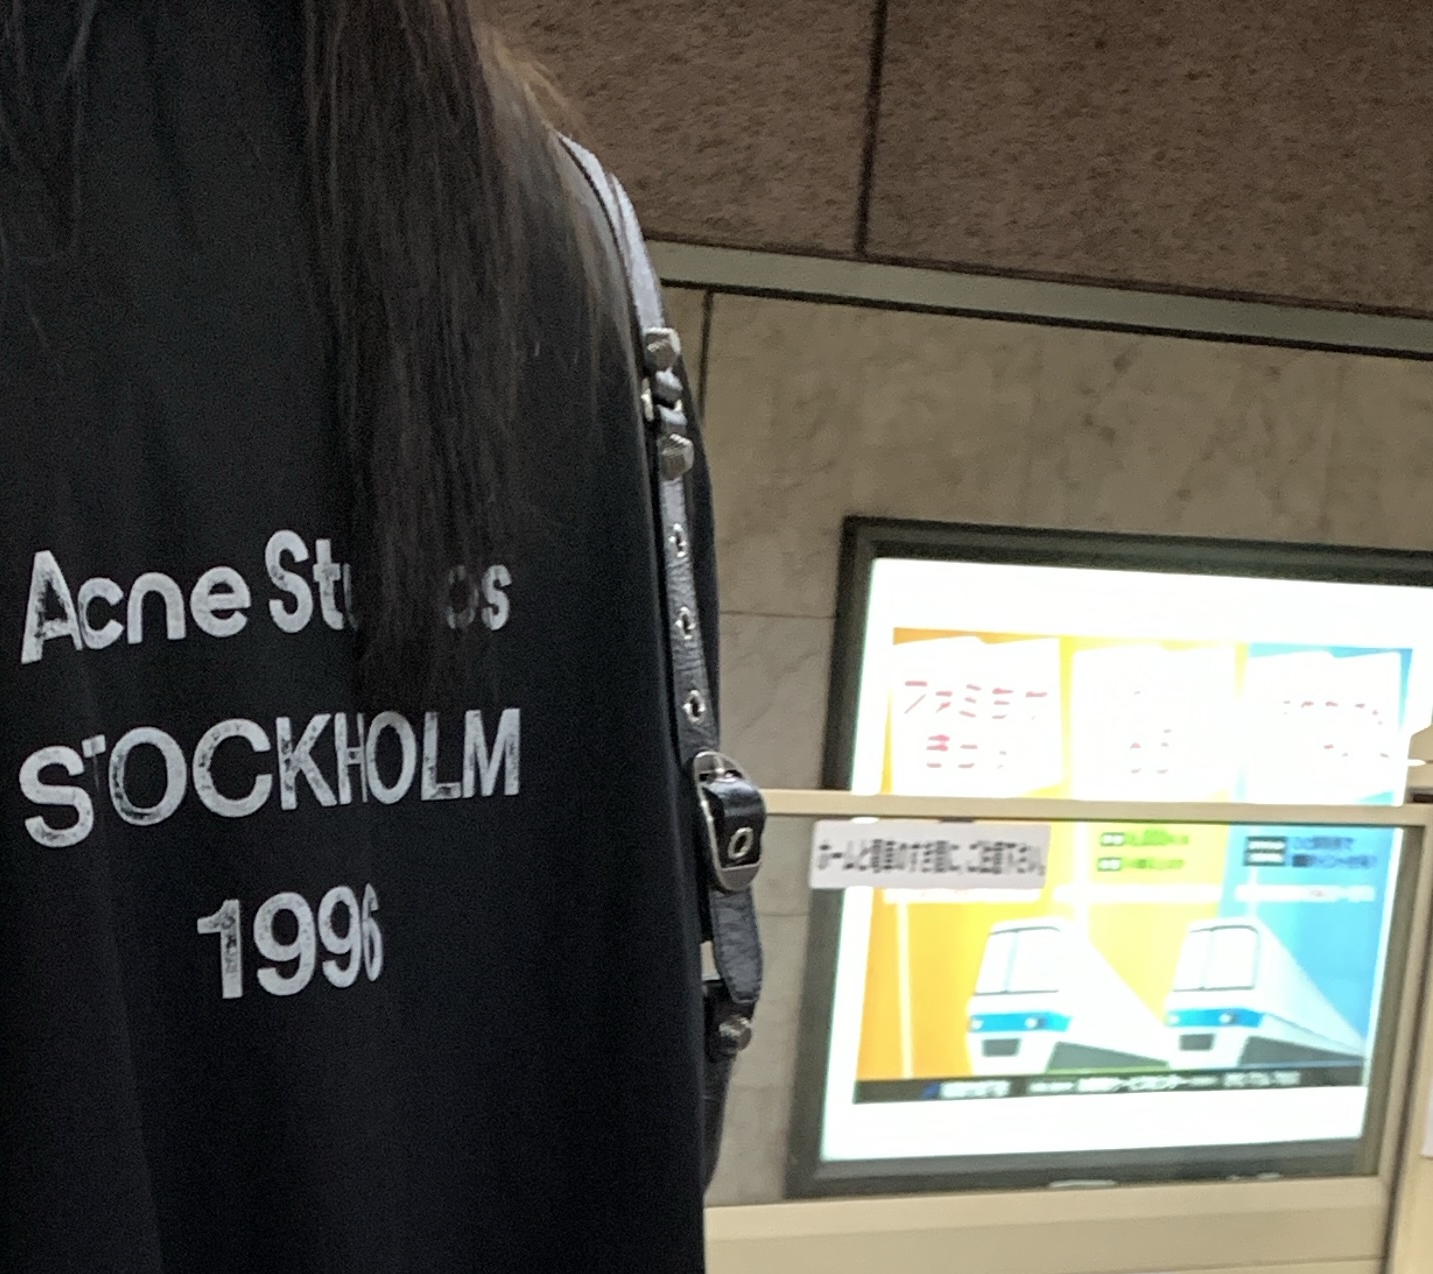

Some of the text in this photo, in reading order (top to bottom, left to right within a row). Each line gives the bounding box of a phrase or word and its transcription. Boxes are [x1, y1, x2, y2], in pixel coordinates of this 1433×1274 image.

[20, 529, 512, 664] Acne Stos
[196, 882, 384, 998] 1996
